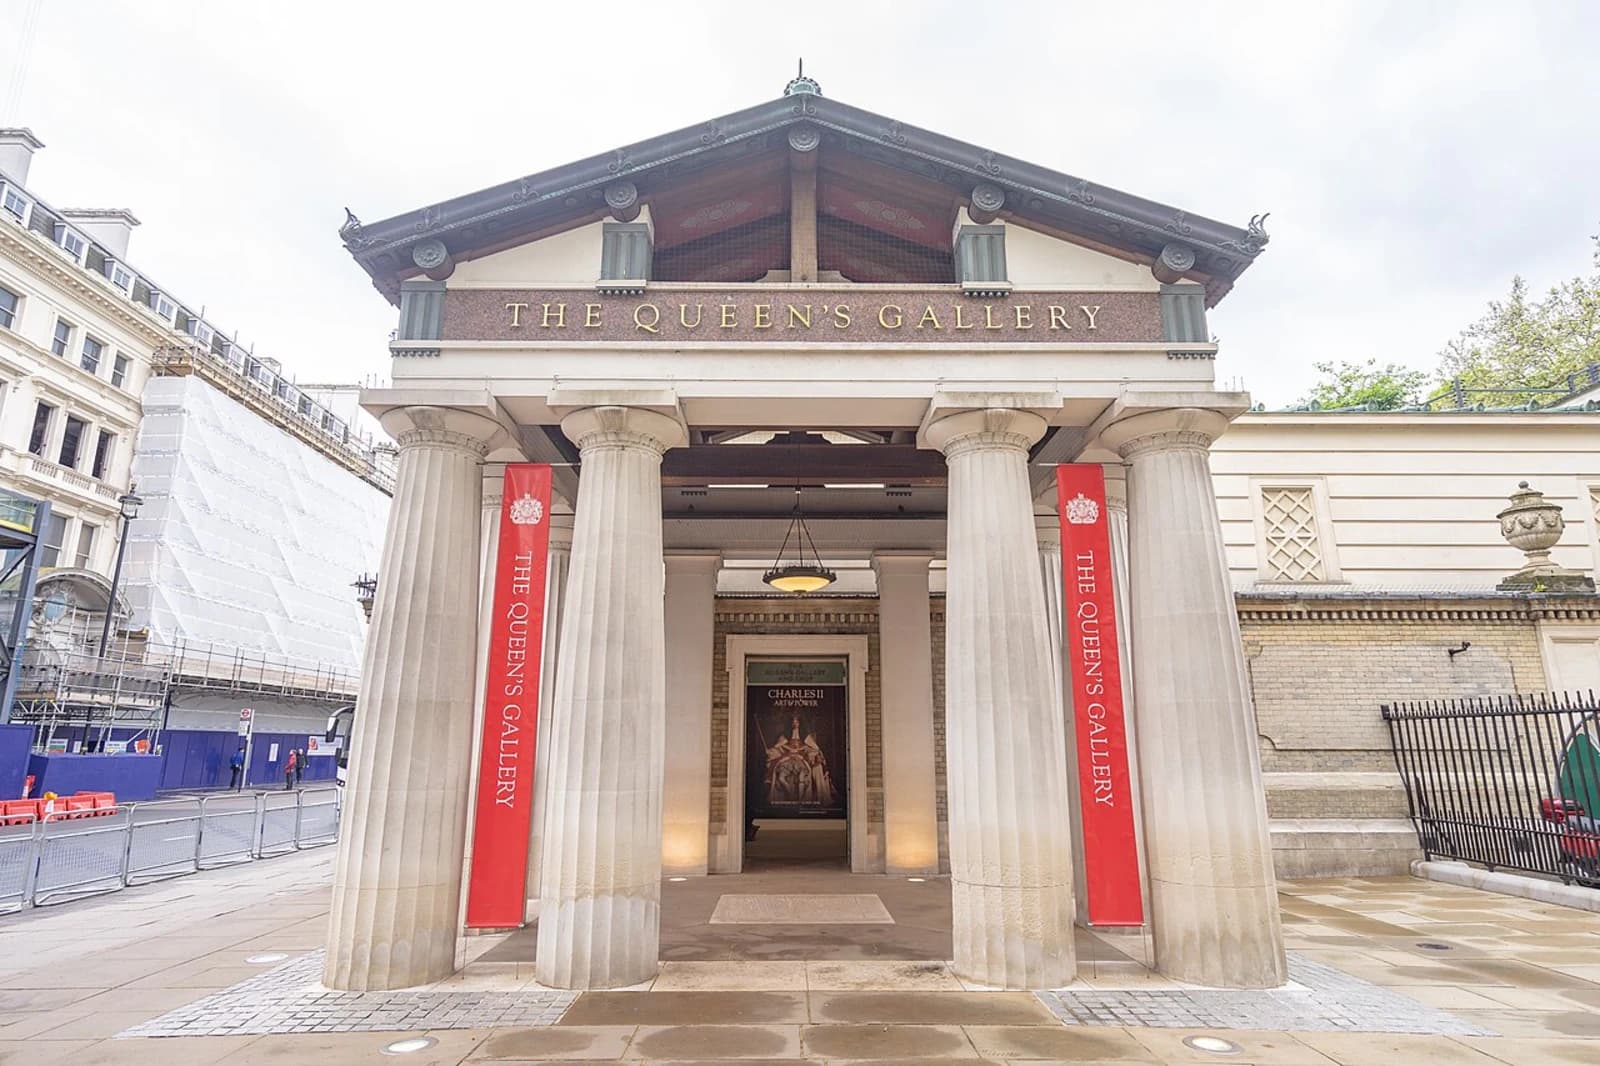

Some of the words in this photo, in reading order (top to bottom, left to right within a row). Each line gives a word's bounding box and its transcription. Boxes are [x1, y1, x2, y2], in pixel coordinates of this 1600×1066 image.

[505, 303, 602, 328] THE
[633, 303, 852, 333] QUEEN'S
[878, 304, 1101, 330] GALLERY
[512, 550, 532, 595] THE
[1076, 550, 1096, 594] THE
[504, 602, 529, 697] QUEEN'S
[1077, 601, 1104, 696] QUEEN'S
[768, 689, 816, 699] CHARLES
[495, 704, 521, 809] GALLERY
[1087, 703, 1114, 807] GALLERY
